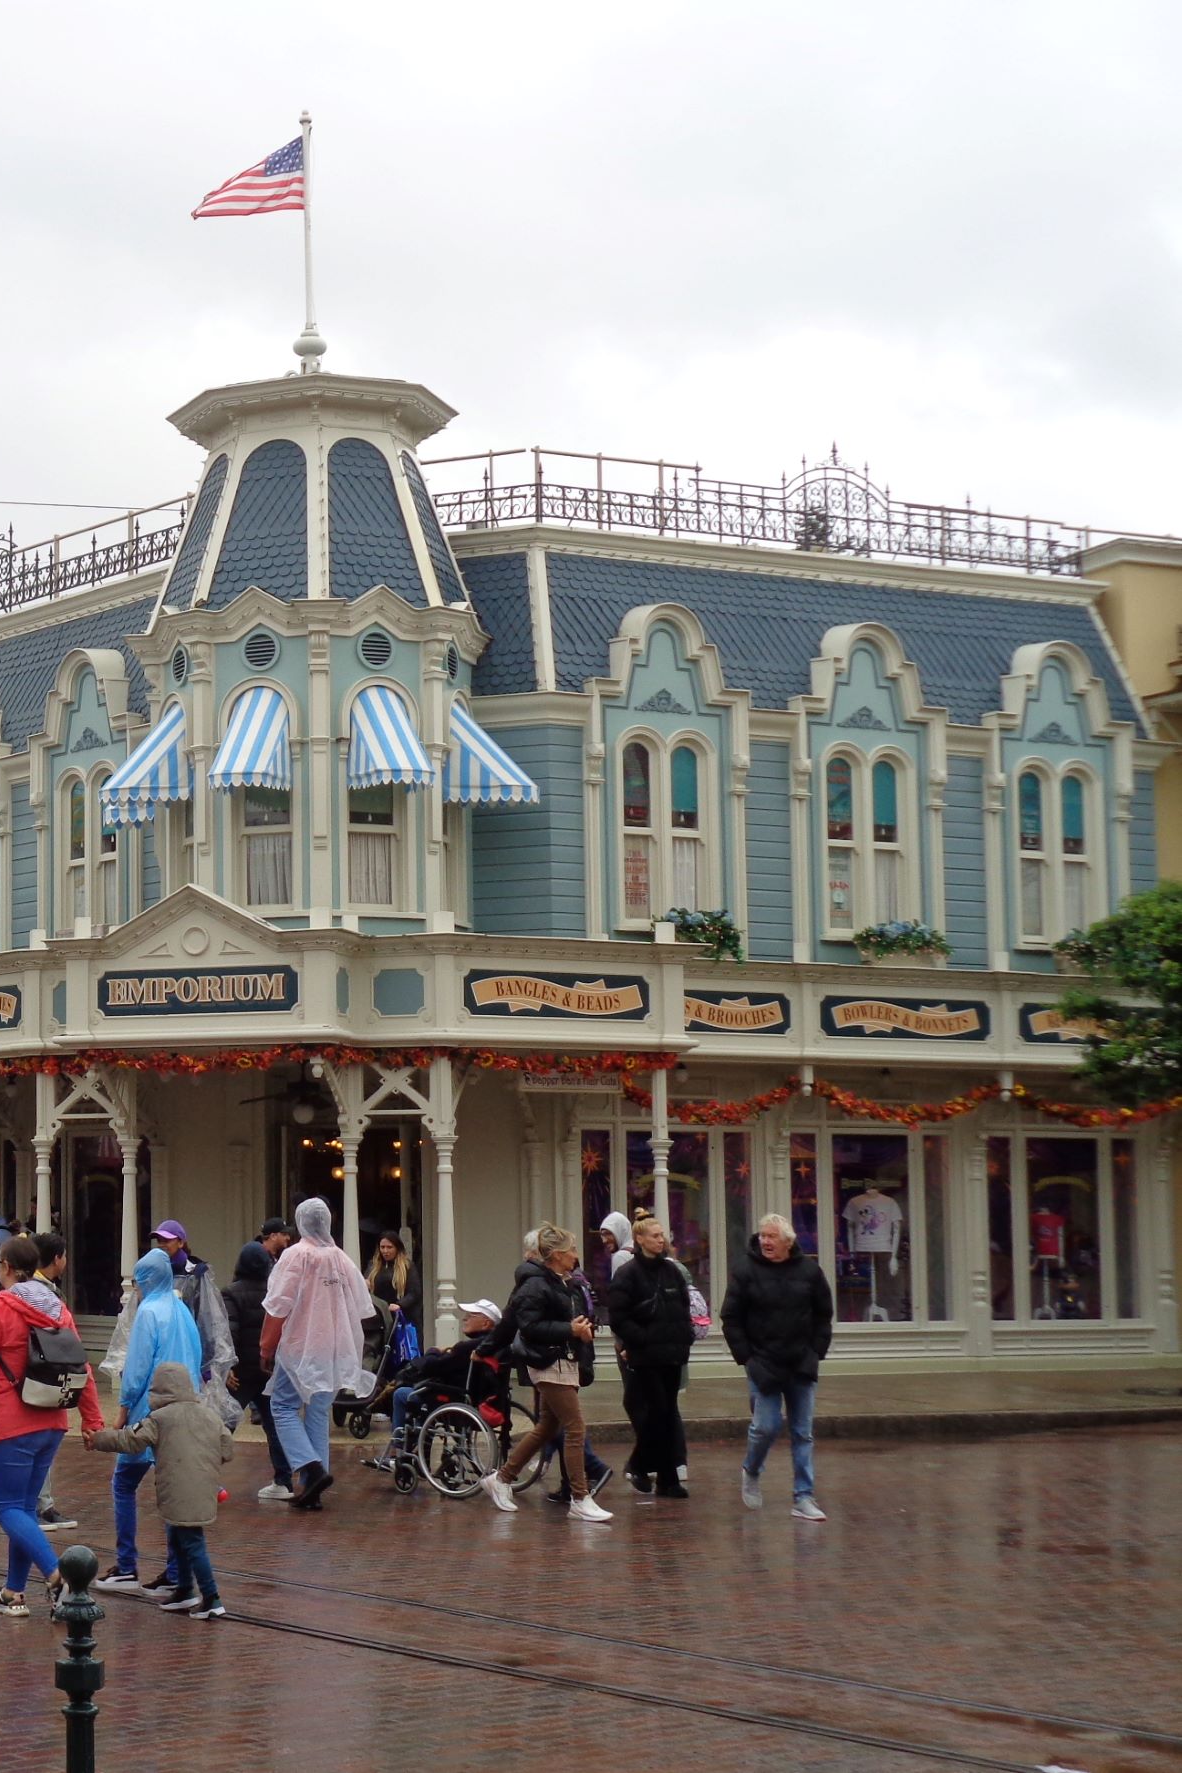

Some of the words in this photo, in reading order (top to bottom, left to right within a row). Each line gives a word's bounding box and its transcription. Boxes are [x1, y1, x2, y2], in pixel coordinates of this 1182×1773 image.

[107, 973, 285, 1006] EMPORIUM
[495, 980, 557, 1003] BANGLES
[562, 992, 572, 1007] &
[577, 994, 621, 1012] BEADS
[694, 1004, 703, 1018] &
[708, 1006, 776, 1026] BROOCHES
[843, 1003, 899, 1022] BOWLERS
[902, 1013, 910, 1027] &
[914, 1014, 969, 1032] BONNETS
